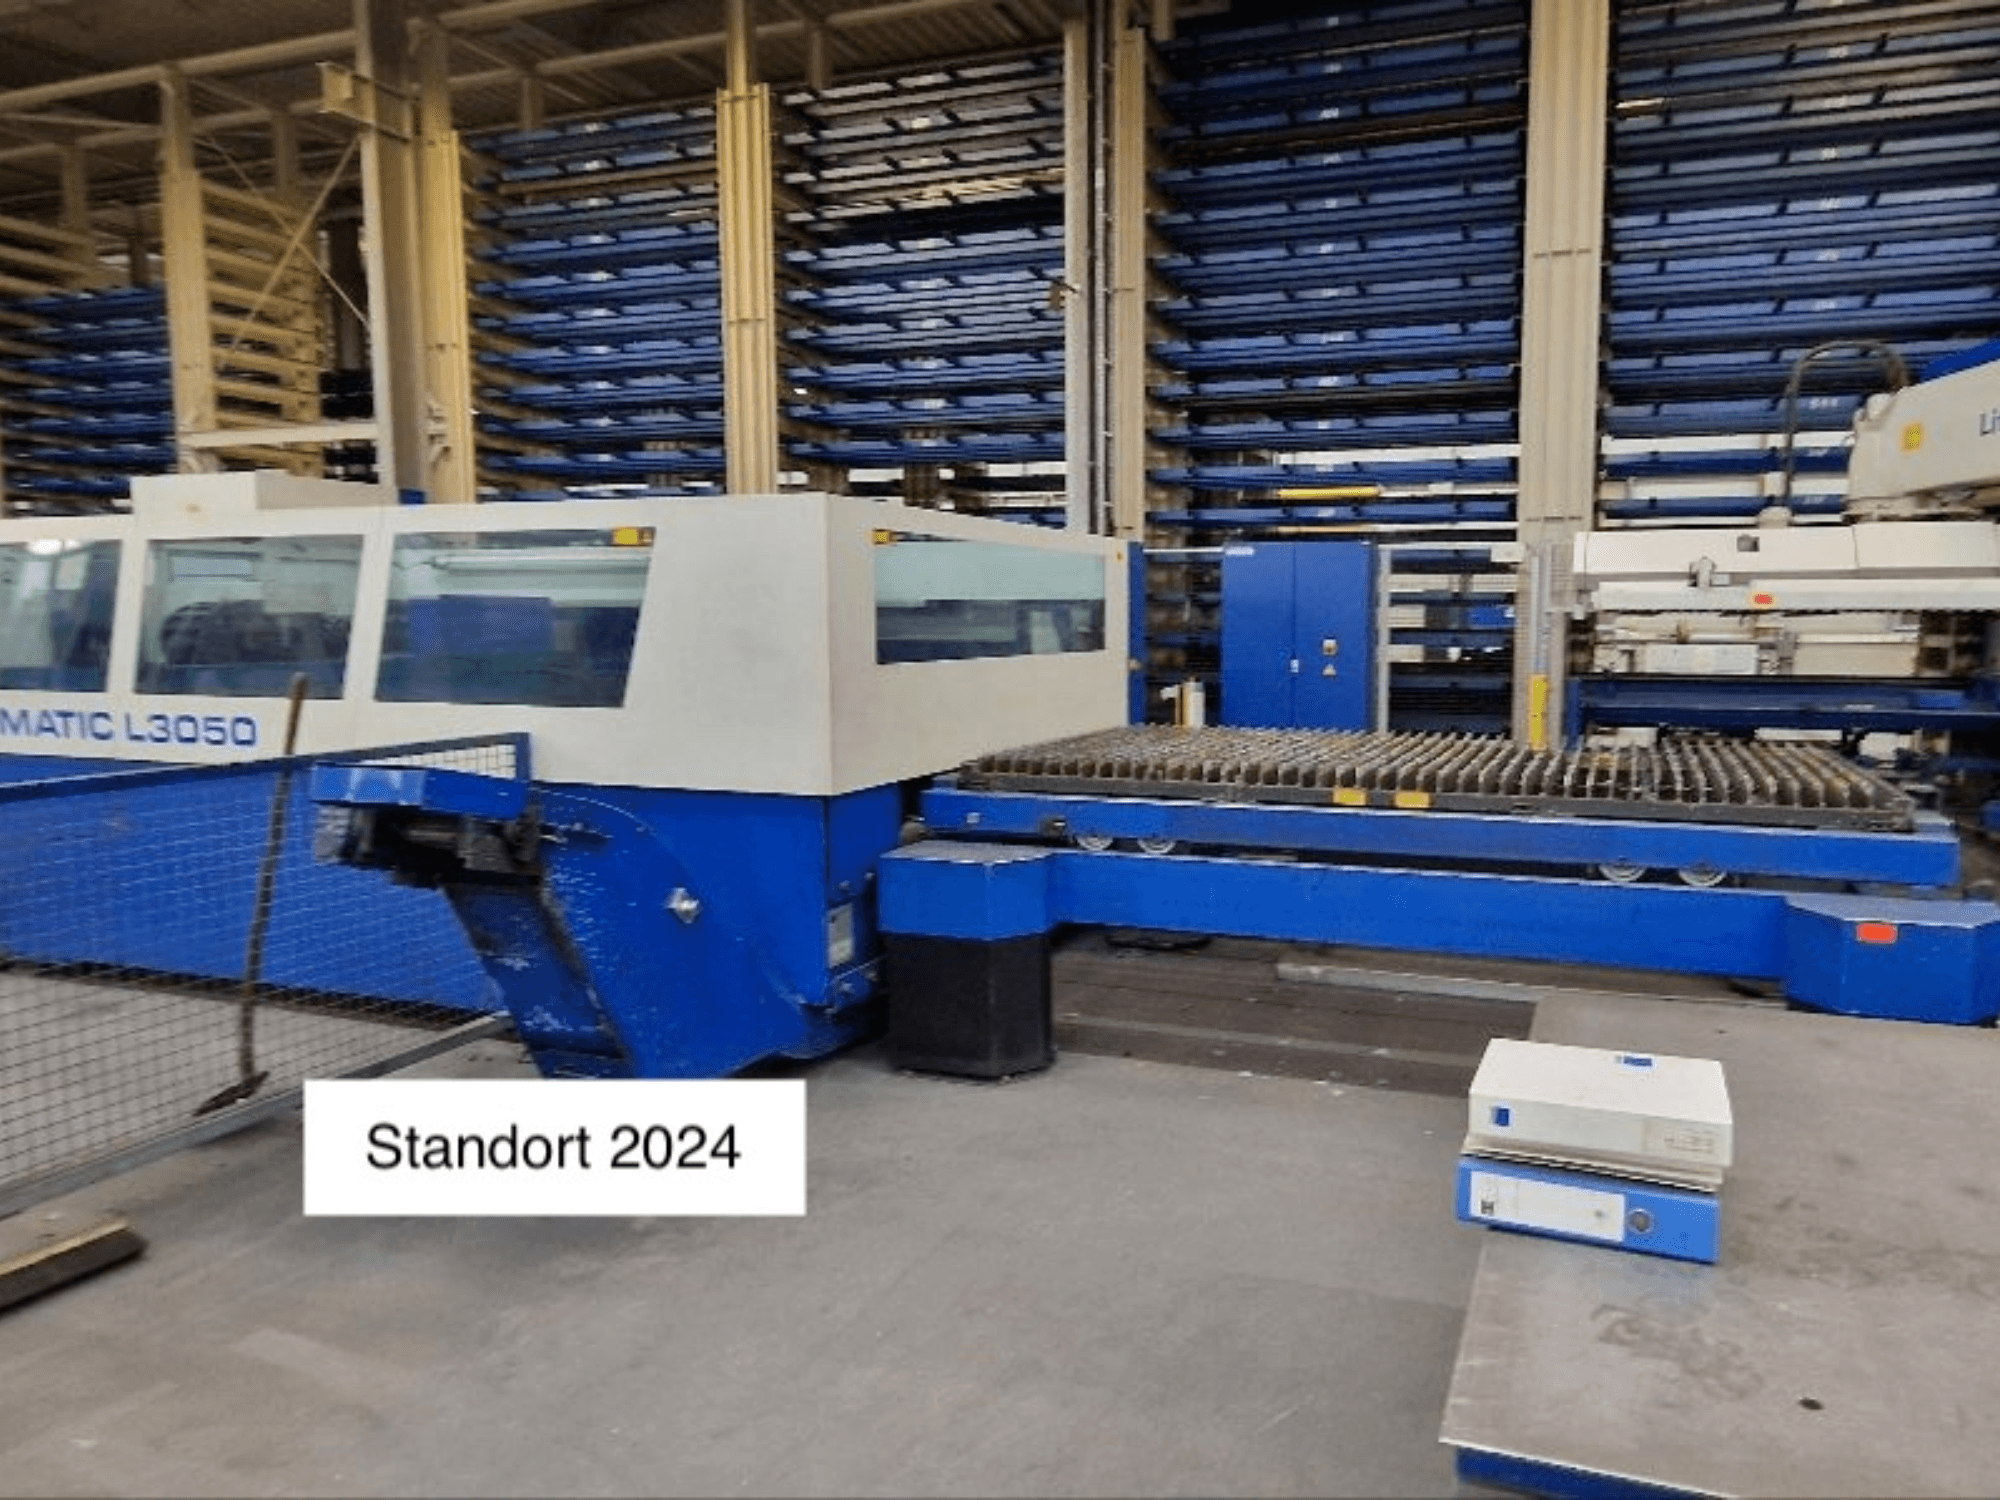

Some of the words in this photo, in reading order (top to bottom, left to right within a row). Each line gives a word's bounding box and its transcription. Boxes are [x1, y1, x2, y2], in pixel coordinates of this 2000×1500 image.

[1979, 408, 2000, 437] Li
[0, 708, 114, 741] MATIC
[124, 711, 257, 746] L3050
